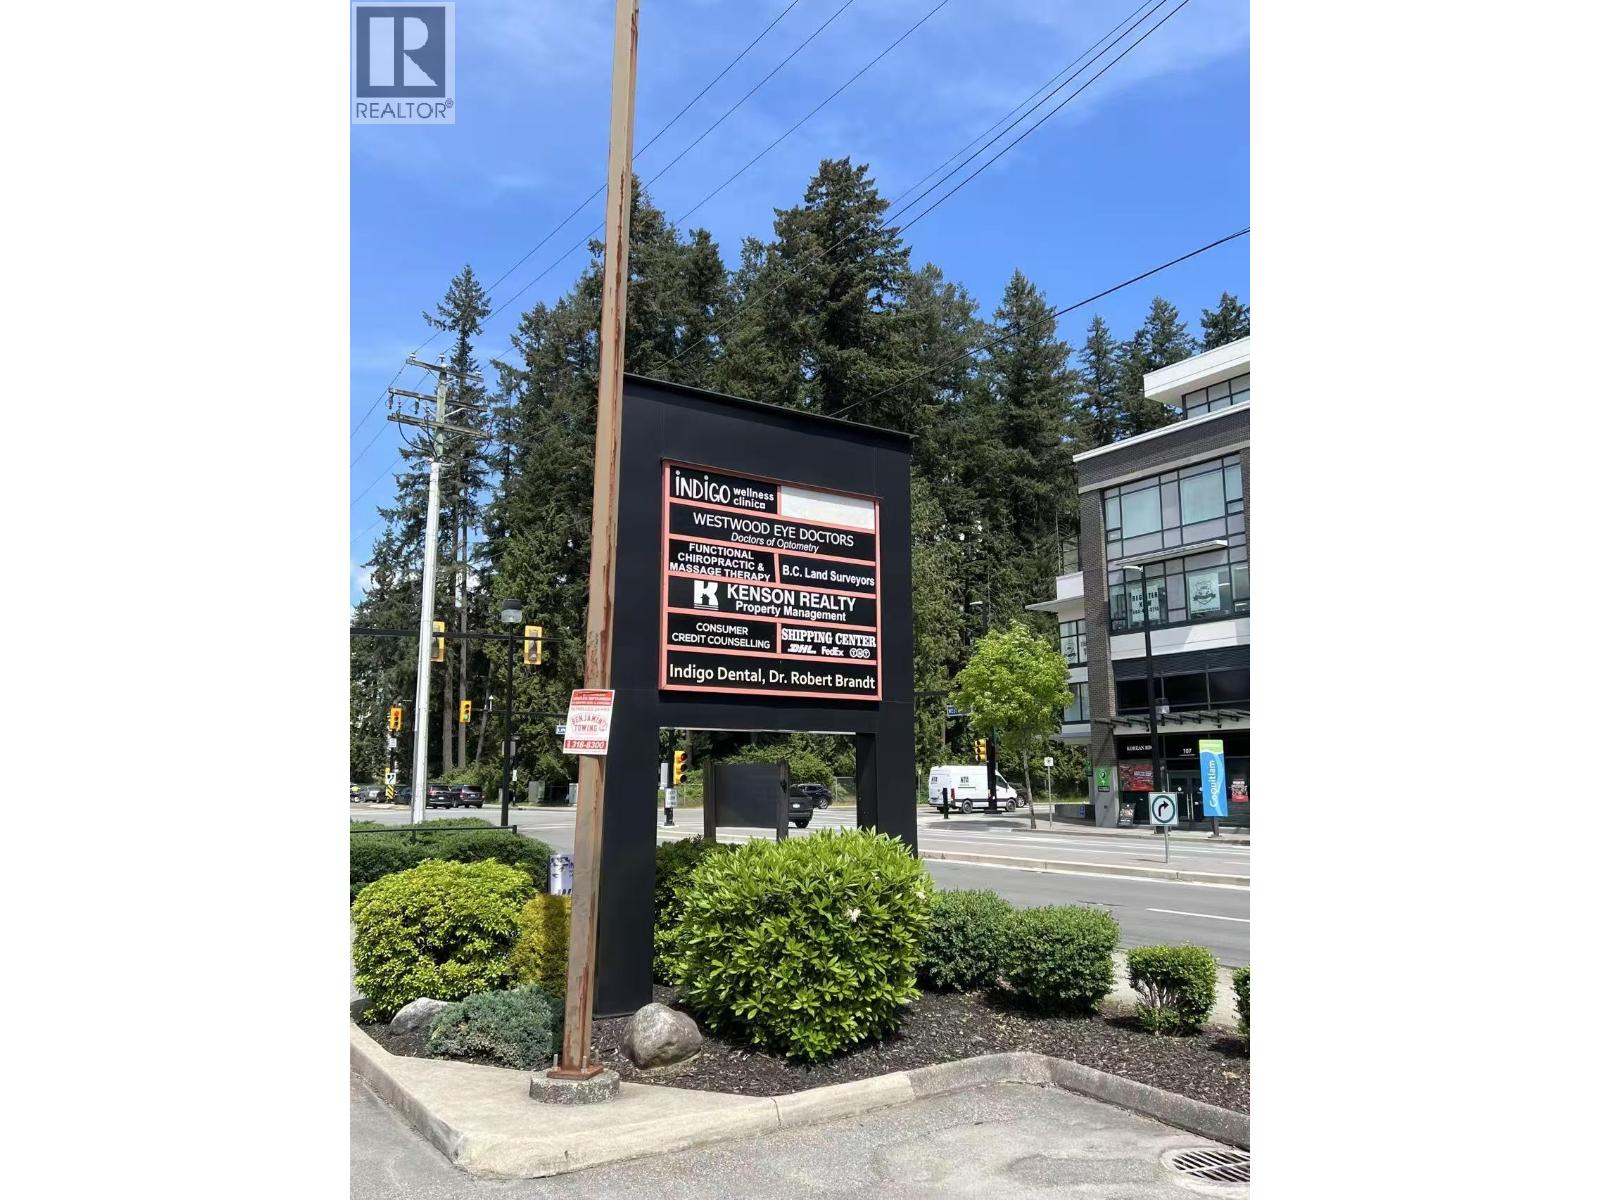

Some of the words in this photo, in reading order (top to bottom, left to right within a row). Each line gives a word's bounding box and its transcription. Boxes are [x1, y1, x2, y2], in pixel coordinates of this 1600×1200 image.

[733, 487, 775, 501] wellness
[693, 512, 770, 535] WESTWOOD
[774, 525, 796, 539] EYE
[800, 528, 854, 547] DOCTORS
[689, 543, 755, 560] FUNCTIONAL
[731, 532, 764, 546] Doctors
[766, 538, 776, 547] of
[776, 539, 819, 553] Optometry
[669, 562, 722, 577] MASSAGE
[724, 568, 771, 582] THERAPY
[677, 552, 755, 570] CHIROPRACTIC
[757, 563, 765, 572] &
[782, 564, 802, 577] B.C.
[804, 568, 828, 580] Land
[830, 571, 875, 587] Surveyors
[727, 583, 795, 606] KENSON
[800, 592, 857, 612] REALTY
[735, 601, 781, 617] Property
[783, 606, 846, 622] Management
[696, 622, 749, 636] CONSUMER
[781, 627, 833, 645] SHIPPING
[835, 632, 877, 648] CENTER
[671, 632, 706, 644] CREDIT
[707, 635, 771, 649] COUNSELLING
[821, 645, 844, 656] FedEx
[669, 664, 714, 683] Indigo
[717, 667, 766, 685] Dental,
[769, 670, 788, 684] Dr.
[791, 671, 833, 686] Robert
[835, 674, 876, 689] Brandt
[1208, 760, 1218, 808] Coquitlam
